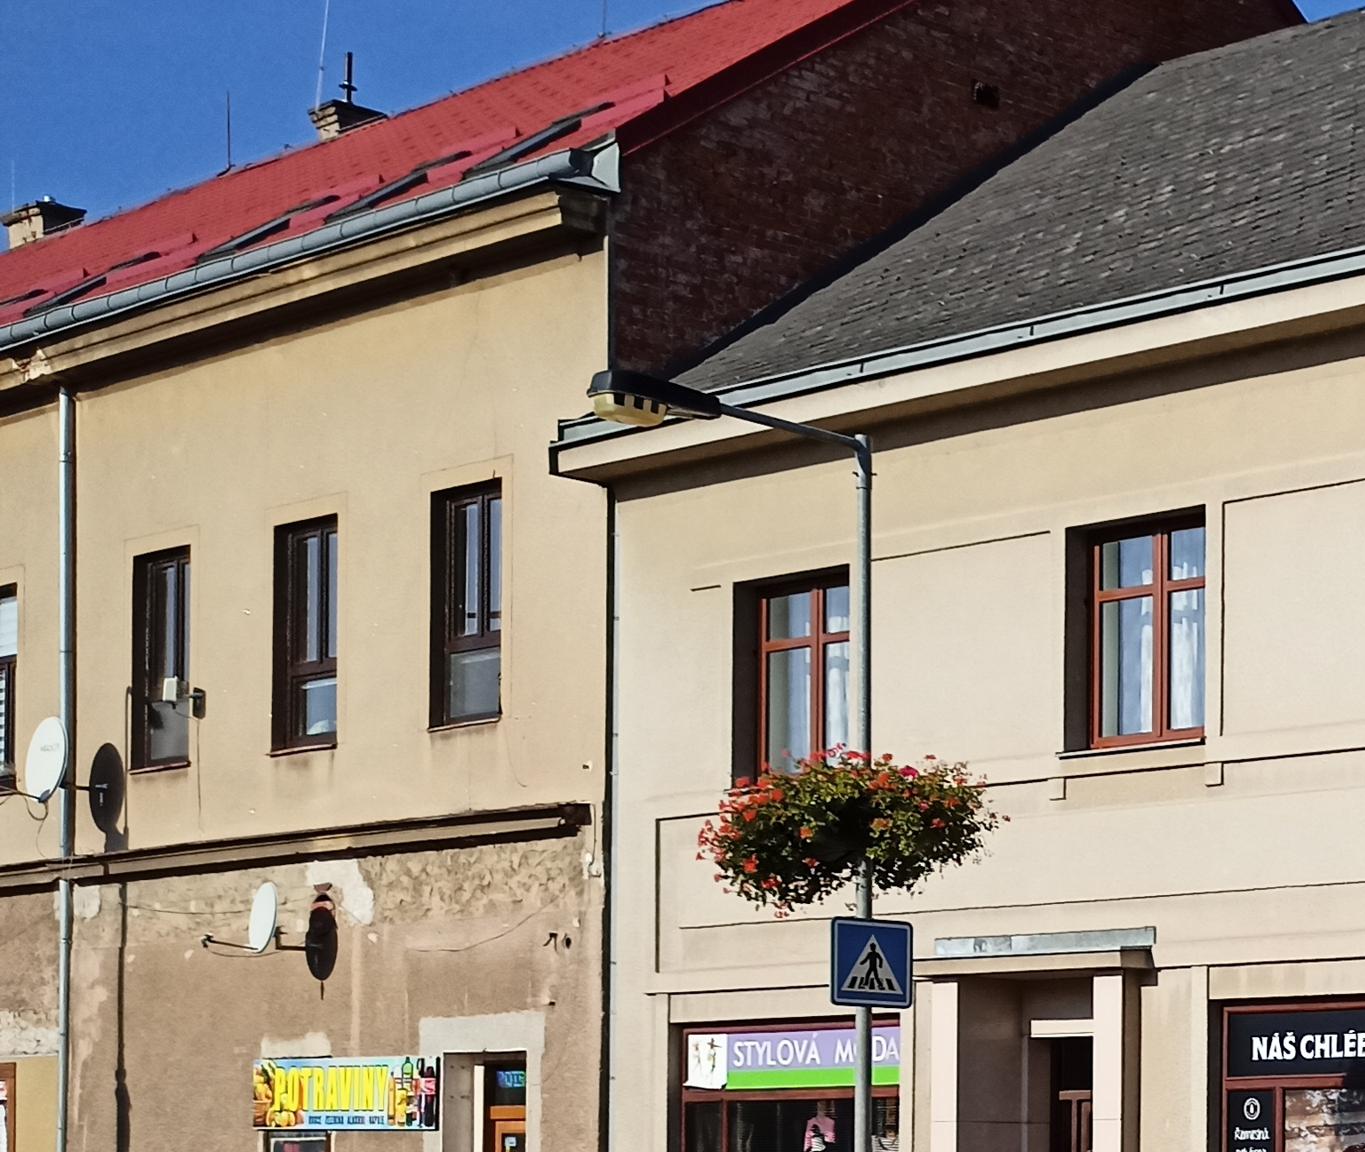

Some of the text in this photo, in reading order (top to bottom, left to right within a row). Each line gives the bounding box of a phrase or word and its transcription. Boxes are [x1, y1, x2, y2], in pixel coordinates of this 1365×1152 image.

[733, 1033, 899, 1067] STYLOVÁ MDA
[1251, 1031, 1297, 1061] NÁŠ
[273, 1065, 389, 1112] POTRAVINY
